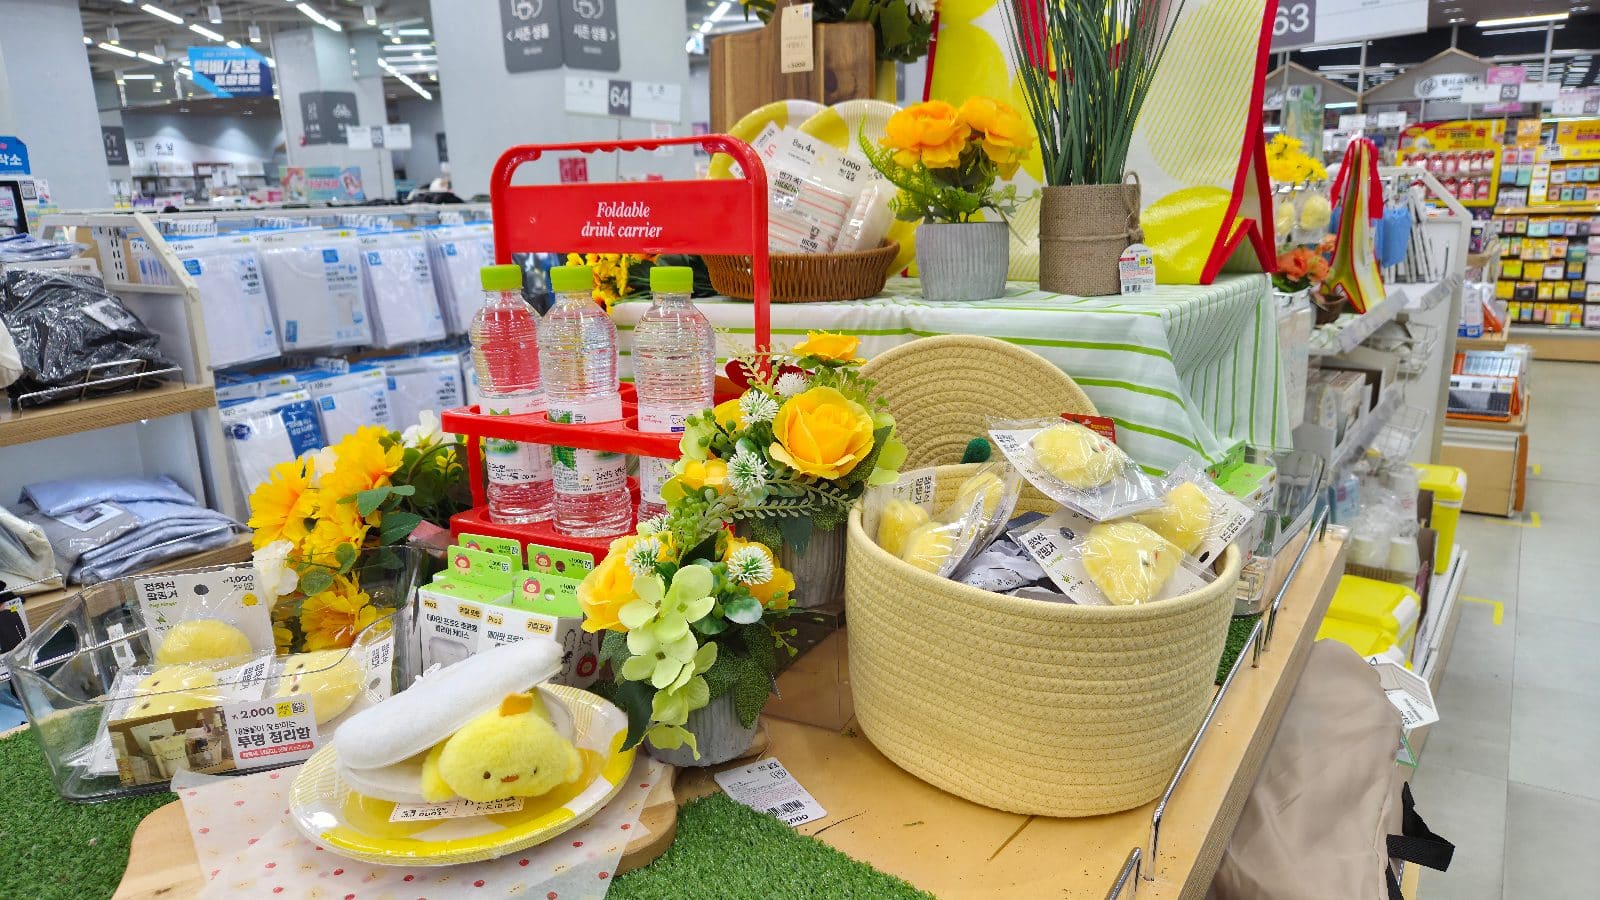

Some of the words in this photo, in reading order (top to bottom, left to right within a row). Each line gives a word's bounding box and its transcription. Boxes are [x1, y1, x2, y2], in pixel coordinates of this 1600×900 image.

[1273, 3, 1310, 36] 63
[610, 85, 630, 109] 64
[596, 201, 651, 218] Foldable
[581, 221, 615, 237] drink
[617, 221, 663, 238] carrier
[237, 733, 266, 748] 투명
[269, 726, 311, 744] 정리함
